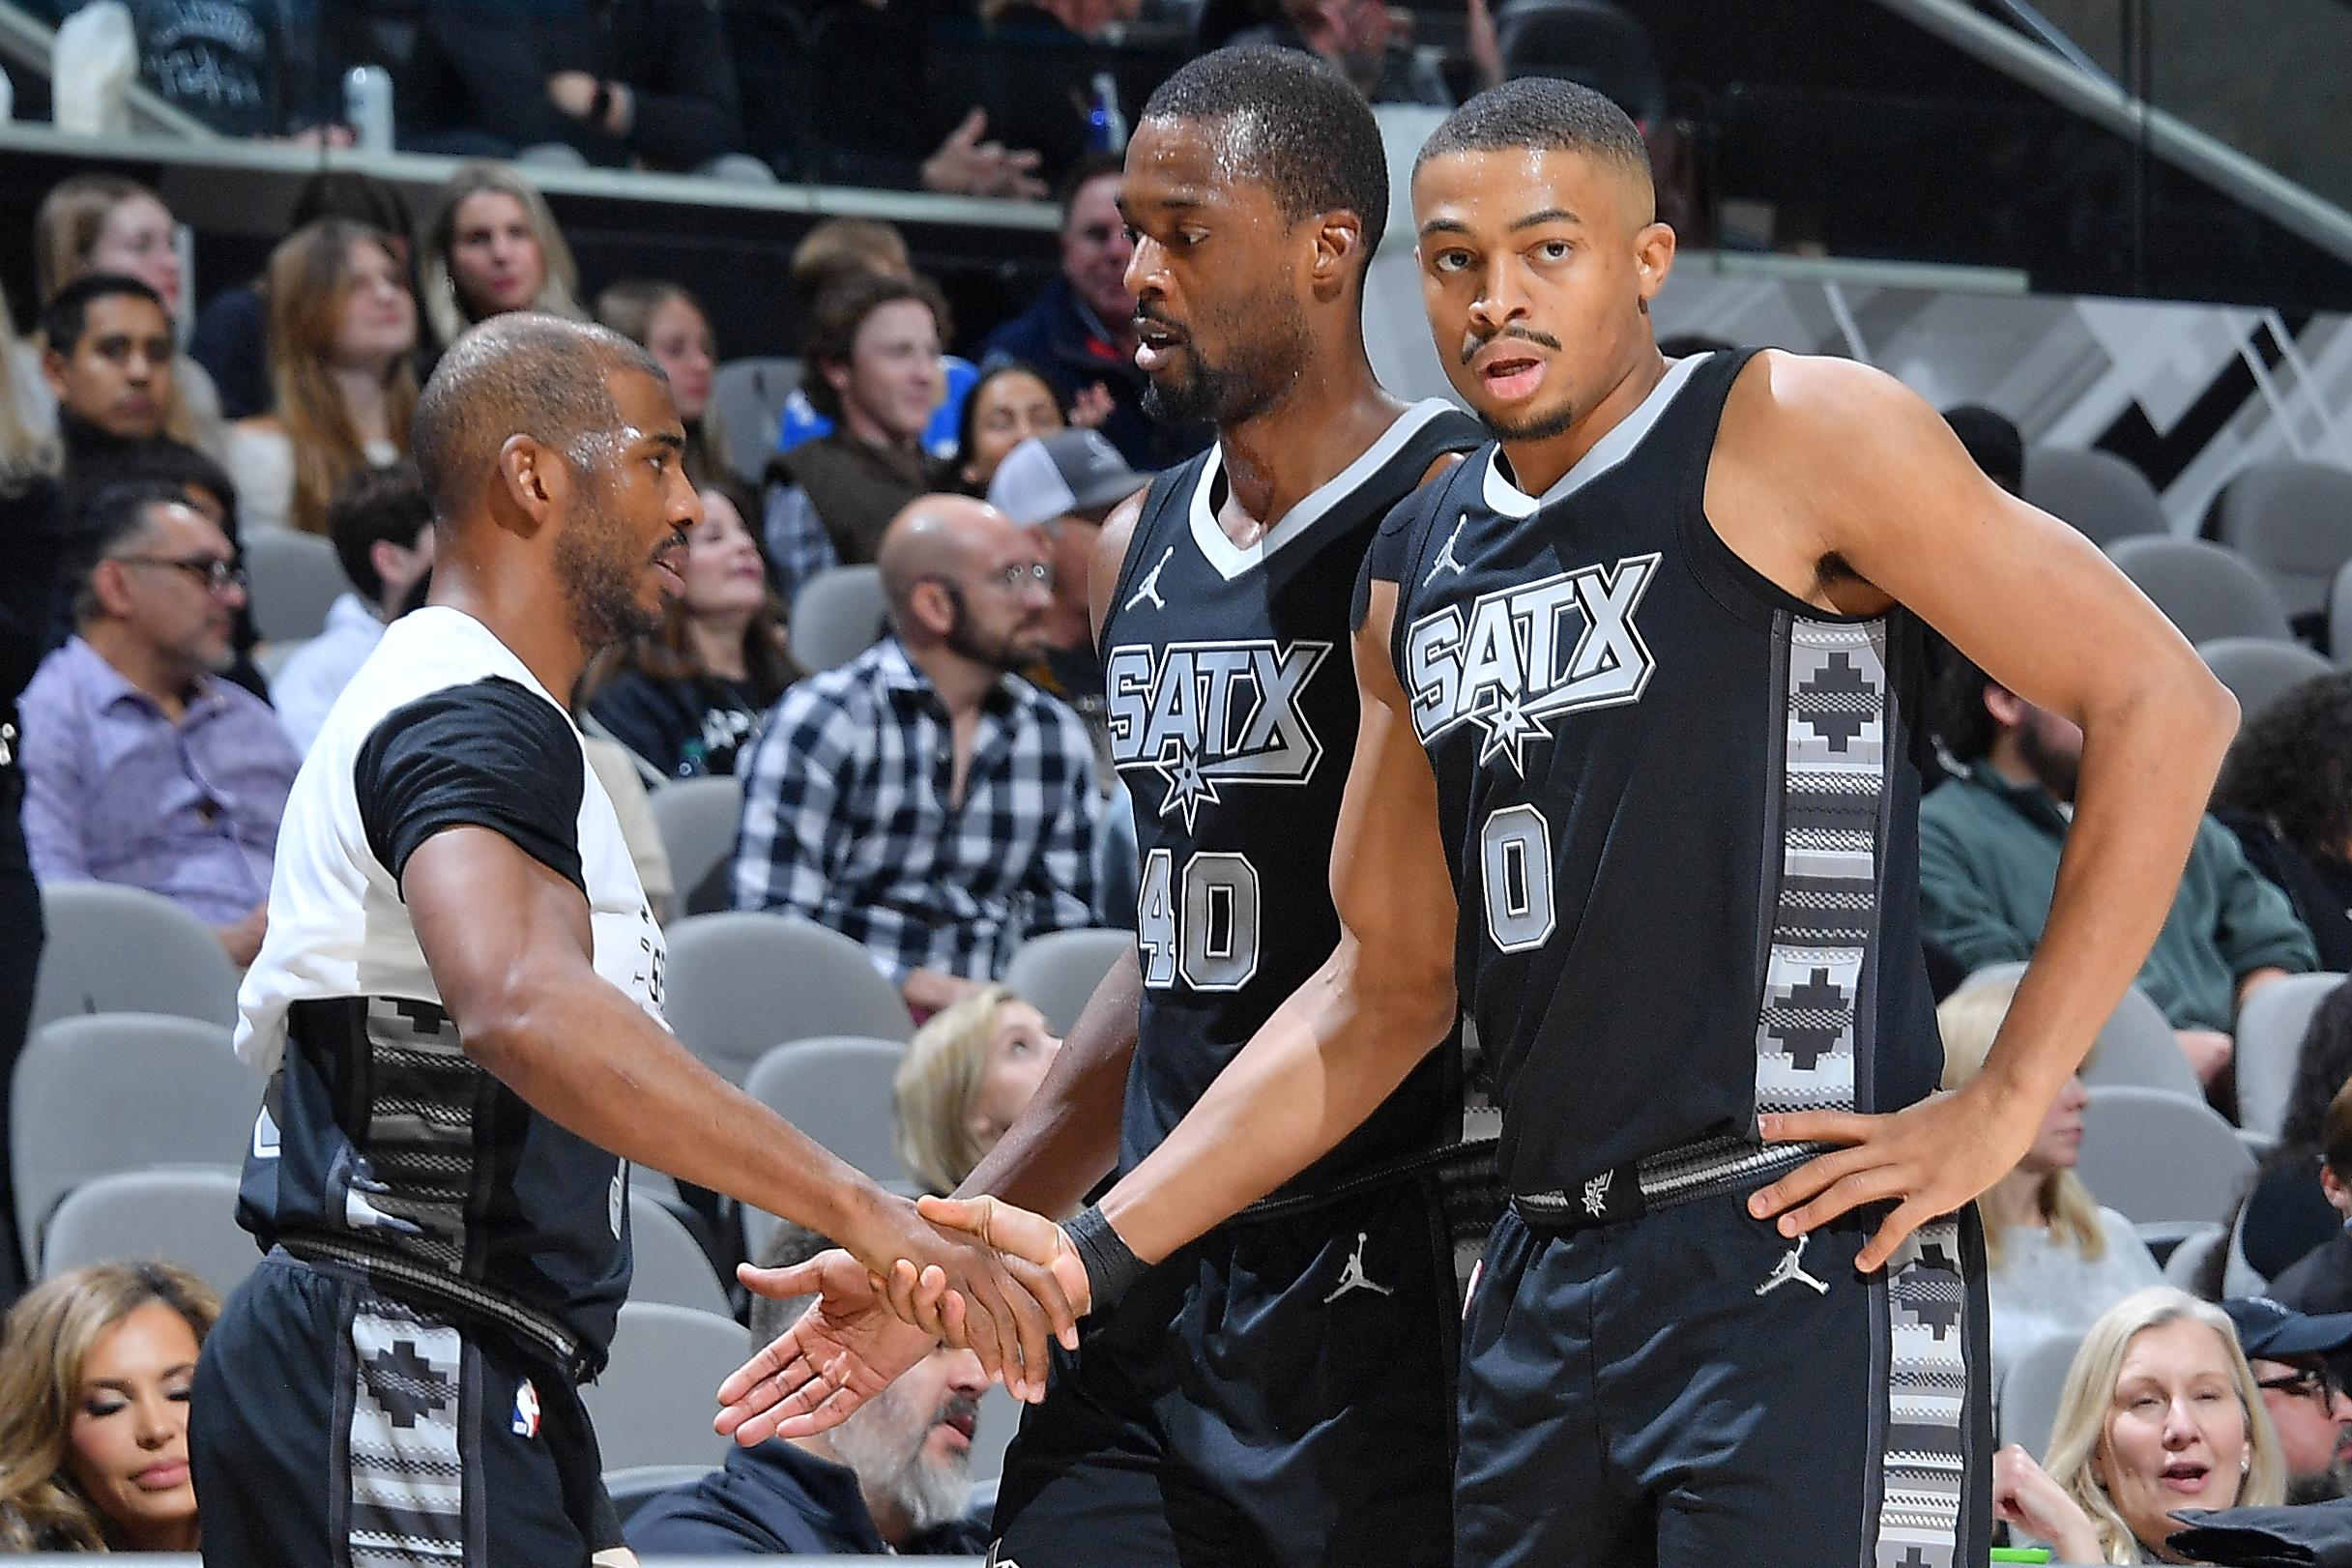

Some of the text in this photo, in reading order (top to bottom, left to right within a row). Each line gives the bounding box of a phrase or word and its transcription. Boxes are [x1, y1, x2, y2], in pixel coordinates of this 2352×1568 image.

[1107, 639, 1334, 785] SATX
[1406, 551, 1663, 746] SATX
[1137, 848, 1261, 992] 40
[1480, 802, 1557, 953] 0
